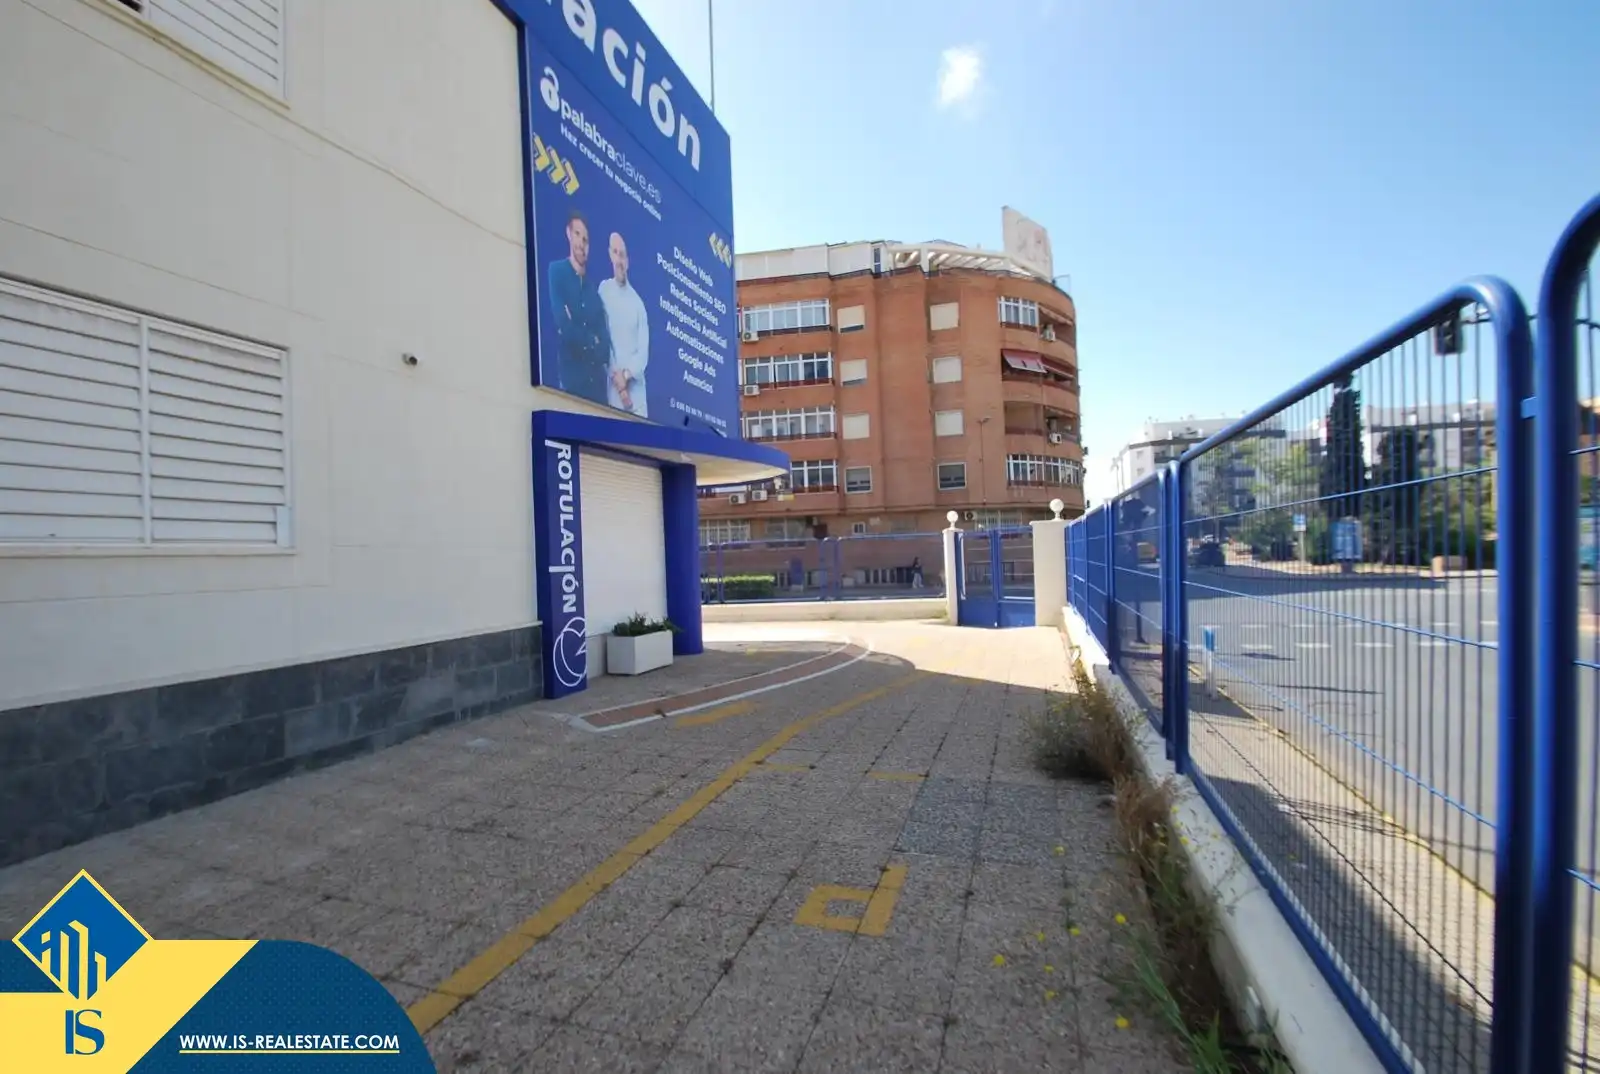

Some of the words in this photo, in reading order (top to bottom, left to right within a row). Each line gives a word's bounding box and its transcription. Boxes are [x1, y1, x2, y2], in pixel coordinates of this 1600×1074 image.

[546, 0, 701, 173] ación
[560, 98, 662, 204] palabraclave.es
[579, 142, 604, 170] crecer
[604, 163, 614, 179] tu
[656, 251, 714, 305] Posicionamiento
[713, 297, 727, 315] SEO
[698, 266, 714, 287] Web
[660, 295, 702, 333] Inteligencia
[701, 324, 728, 349] Artificial
[670, 282, 693, 308] Redes
[692, 299, 719, 327] Sociales
[665, 320, 724, 365] Automatizaciones
[678, 347, 704, 371] Google
[703, 362, 717, 378] Ads
[683, 369, 714, 395] Anuncios
[545, 439, 578, 613] ROTULACIÓN
